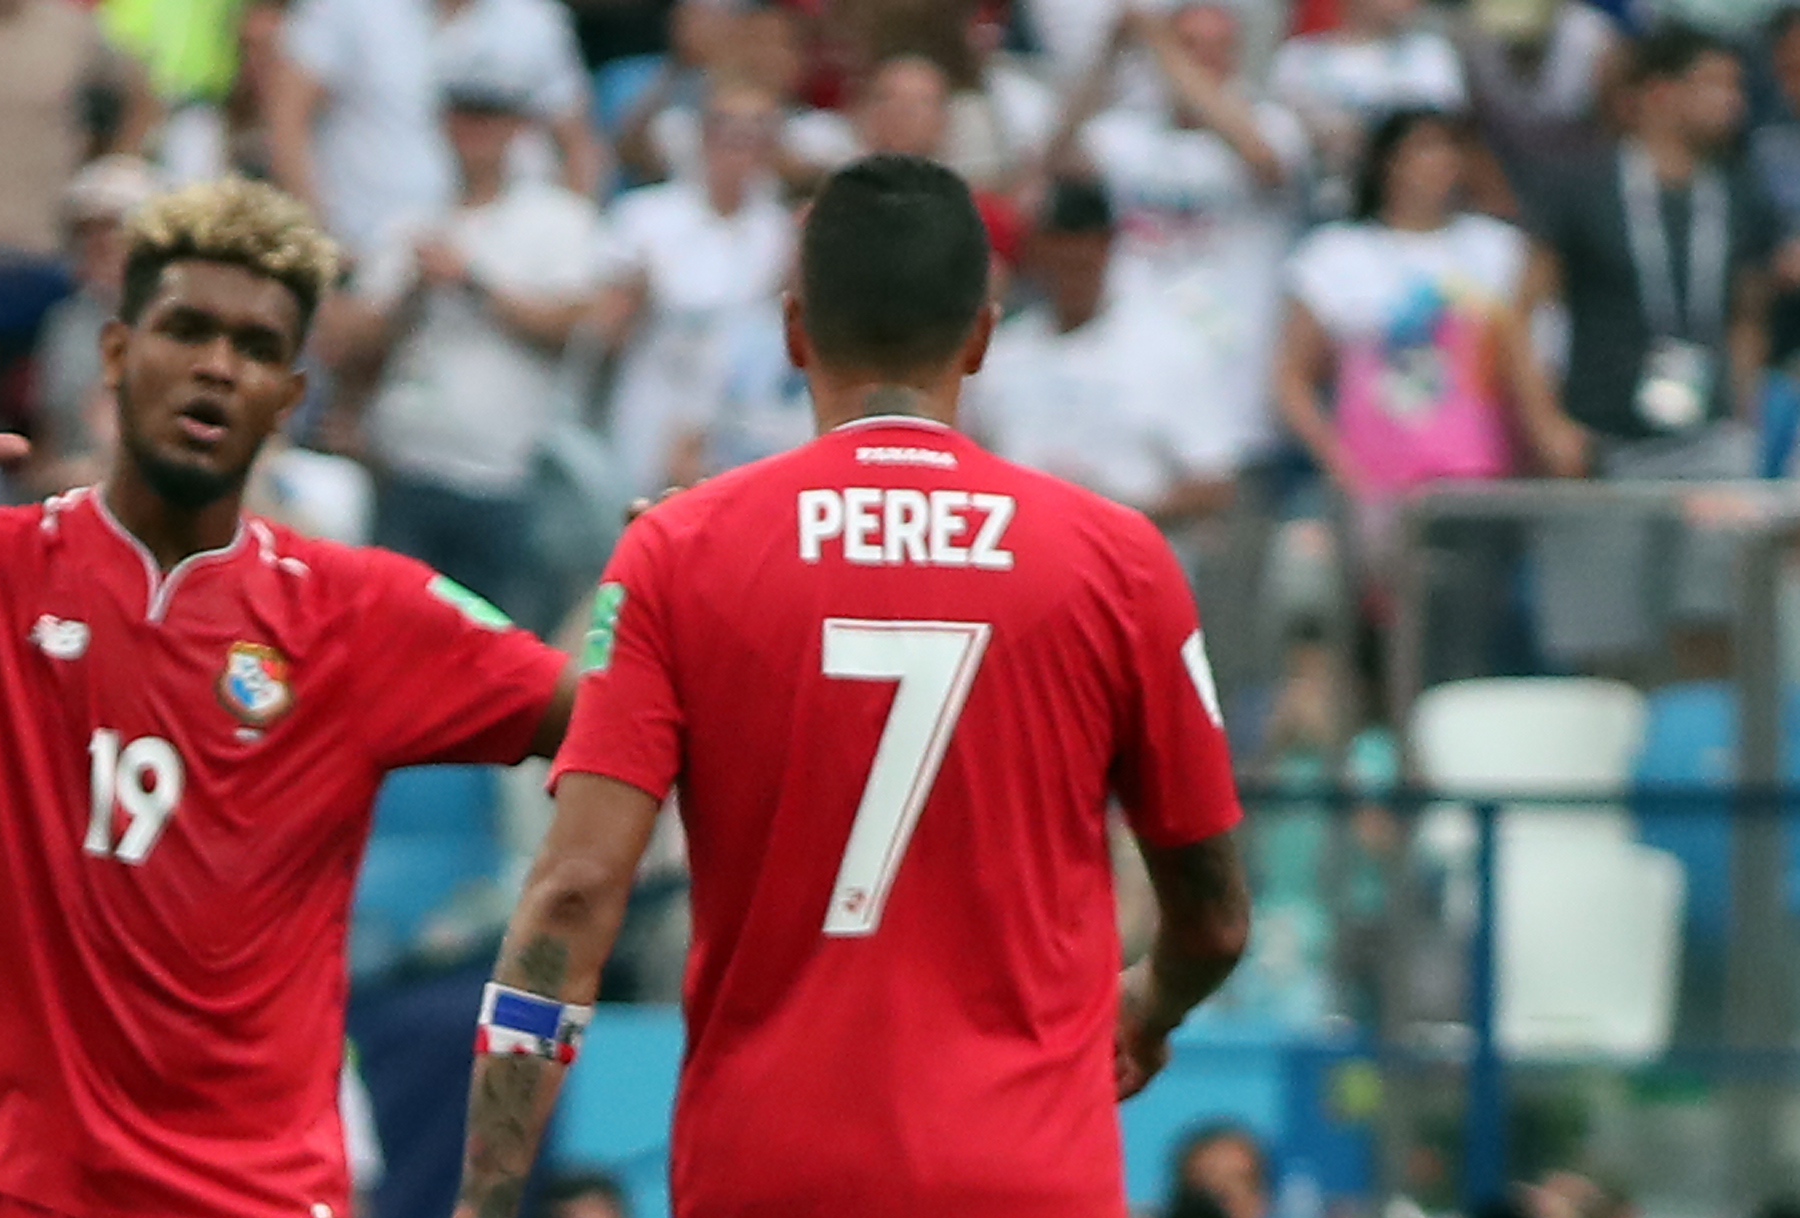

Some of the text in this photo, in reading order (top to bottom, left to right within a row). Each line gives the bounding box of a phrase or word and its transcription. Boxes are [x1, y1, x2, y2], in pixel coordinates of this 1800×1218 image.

[798, 486, 1015, 571] PEREZ
[83, 726, 186, 866] 19
[821, 617, 993, 938] 7
